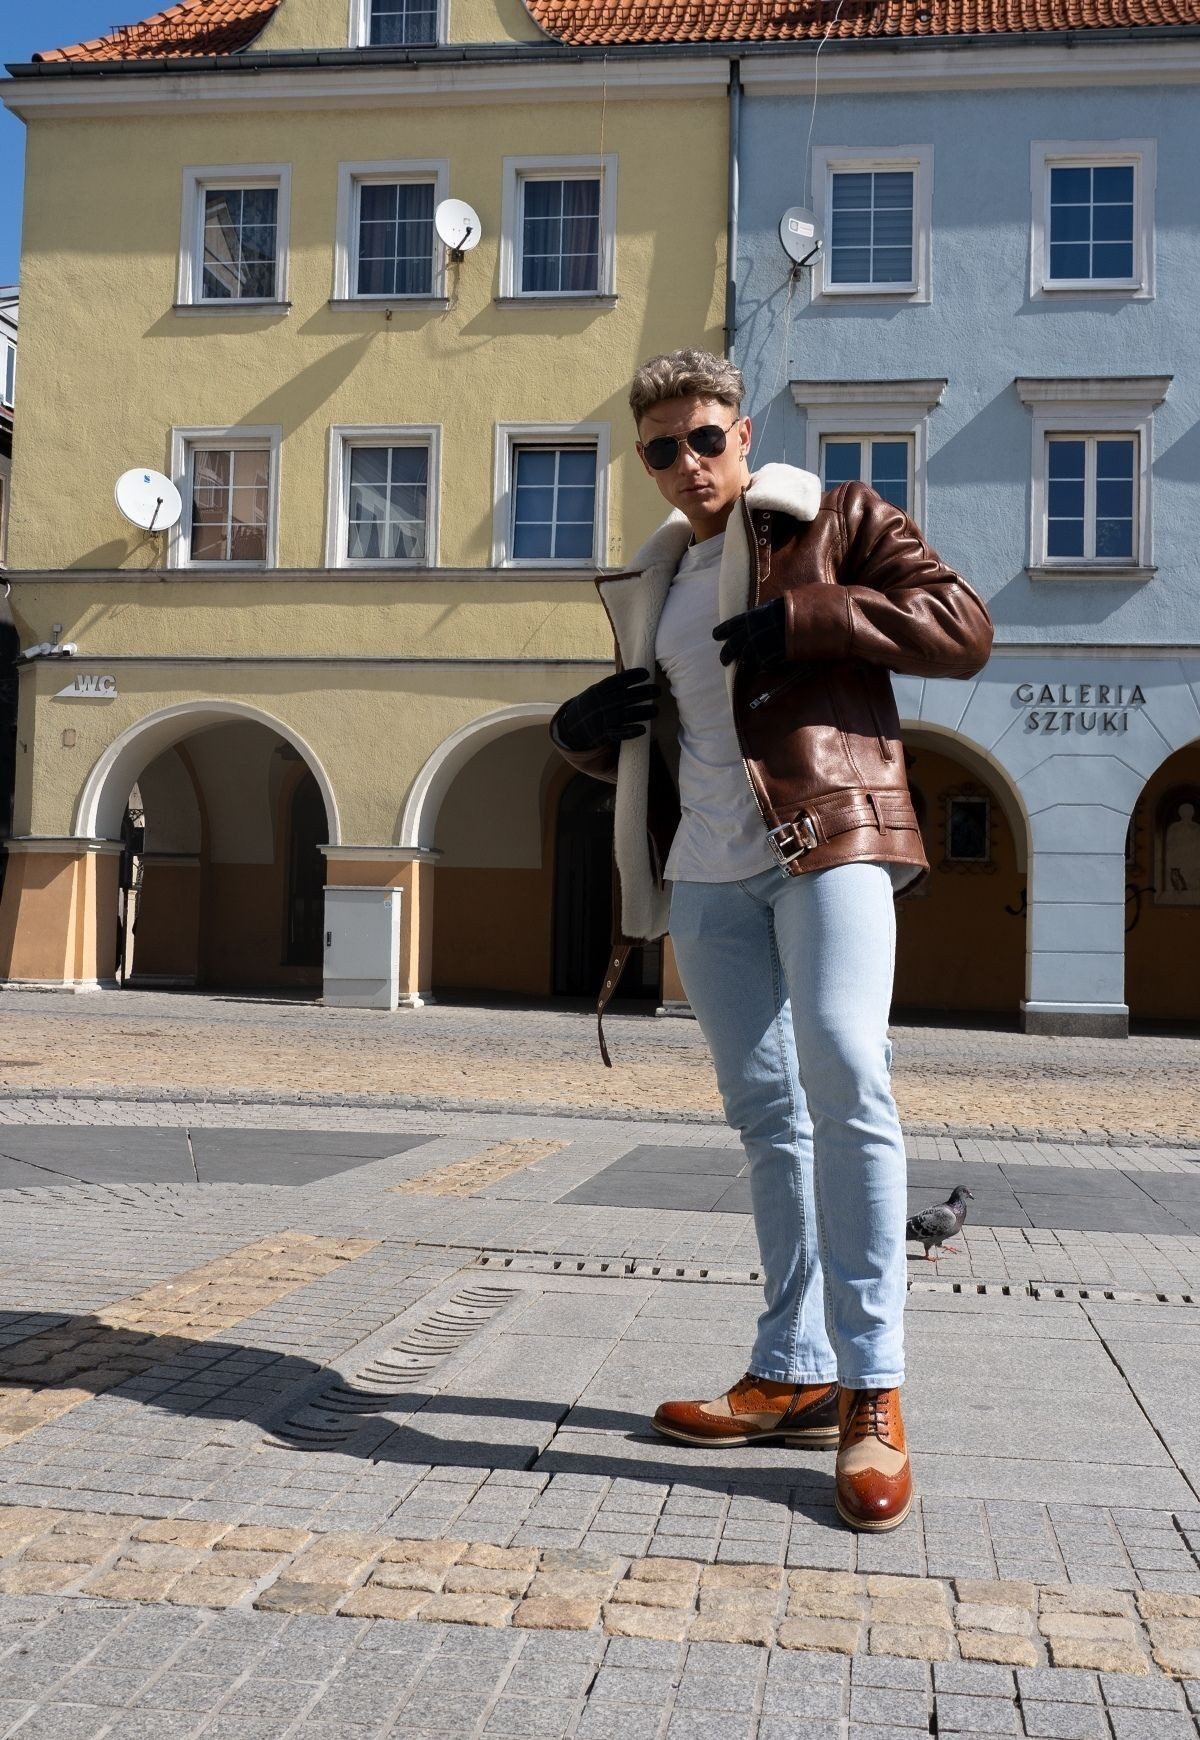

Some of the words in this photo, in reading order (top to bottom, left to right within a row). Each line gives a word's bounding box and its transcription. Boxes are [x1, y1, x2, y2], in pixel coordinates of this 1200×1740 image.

[76, 674, 116, 691] WC
[1016, 683, 1147, 704] GALERIA
[1028, 711, 1128, 731] SZTUKI
